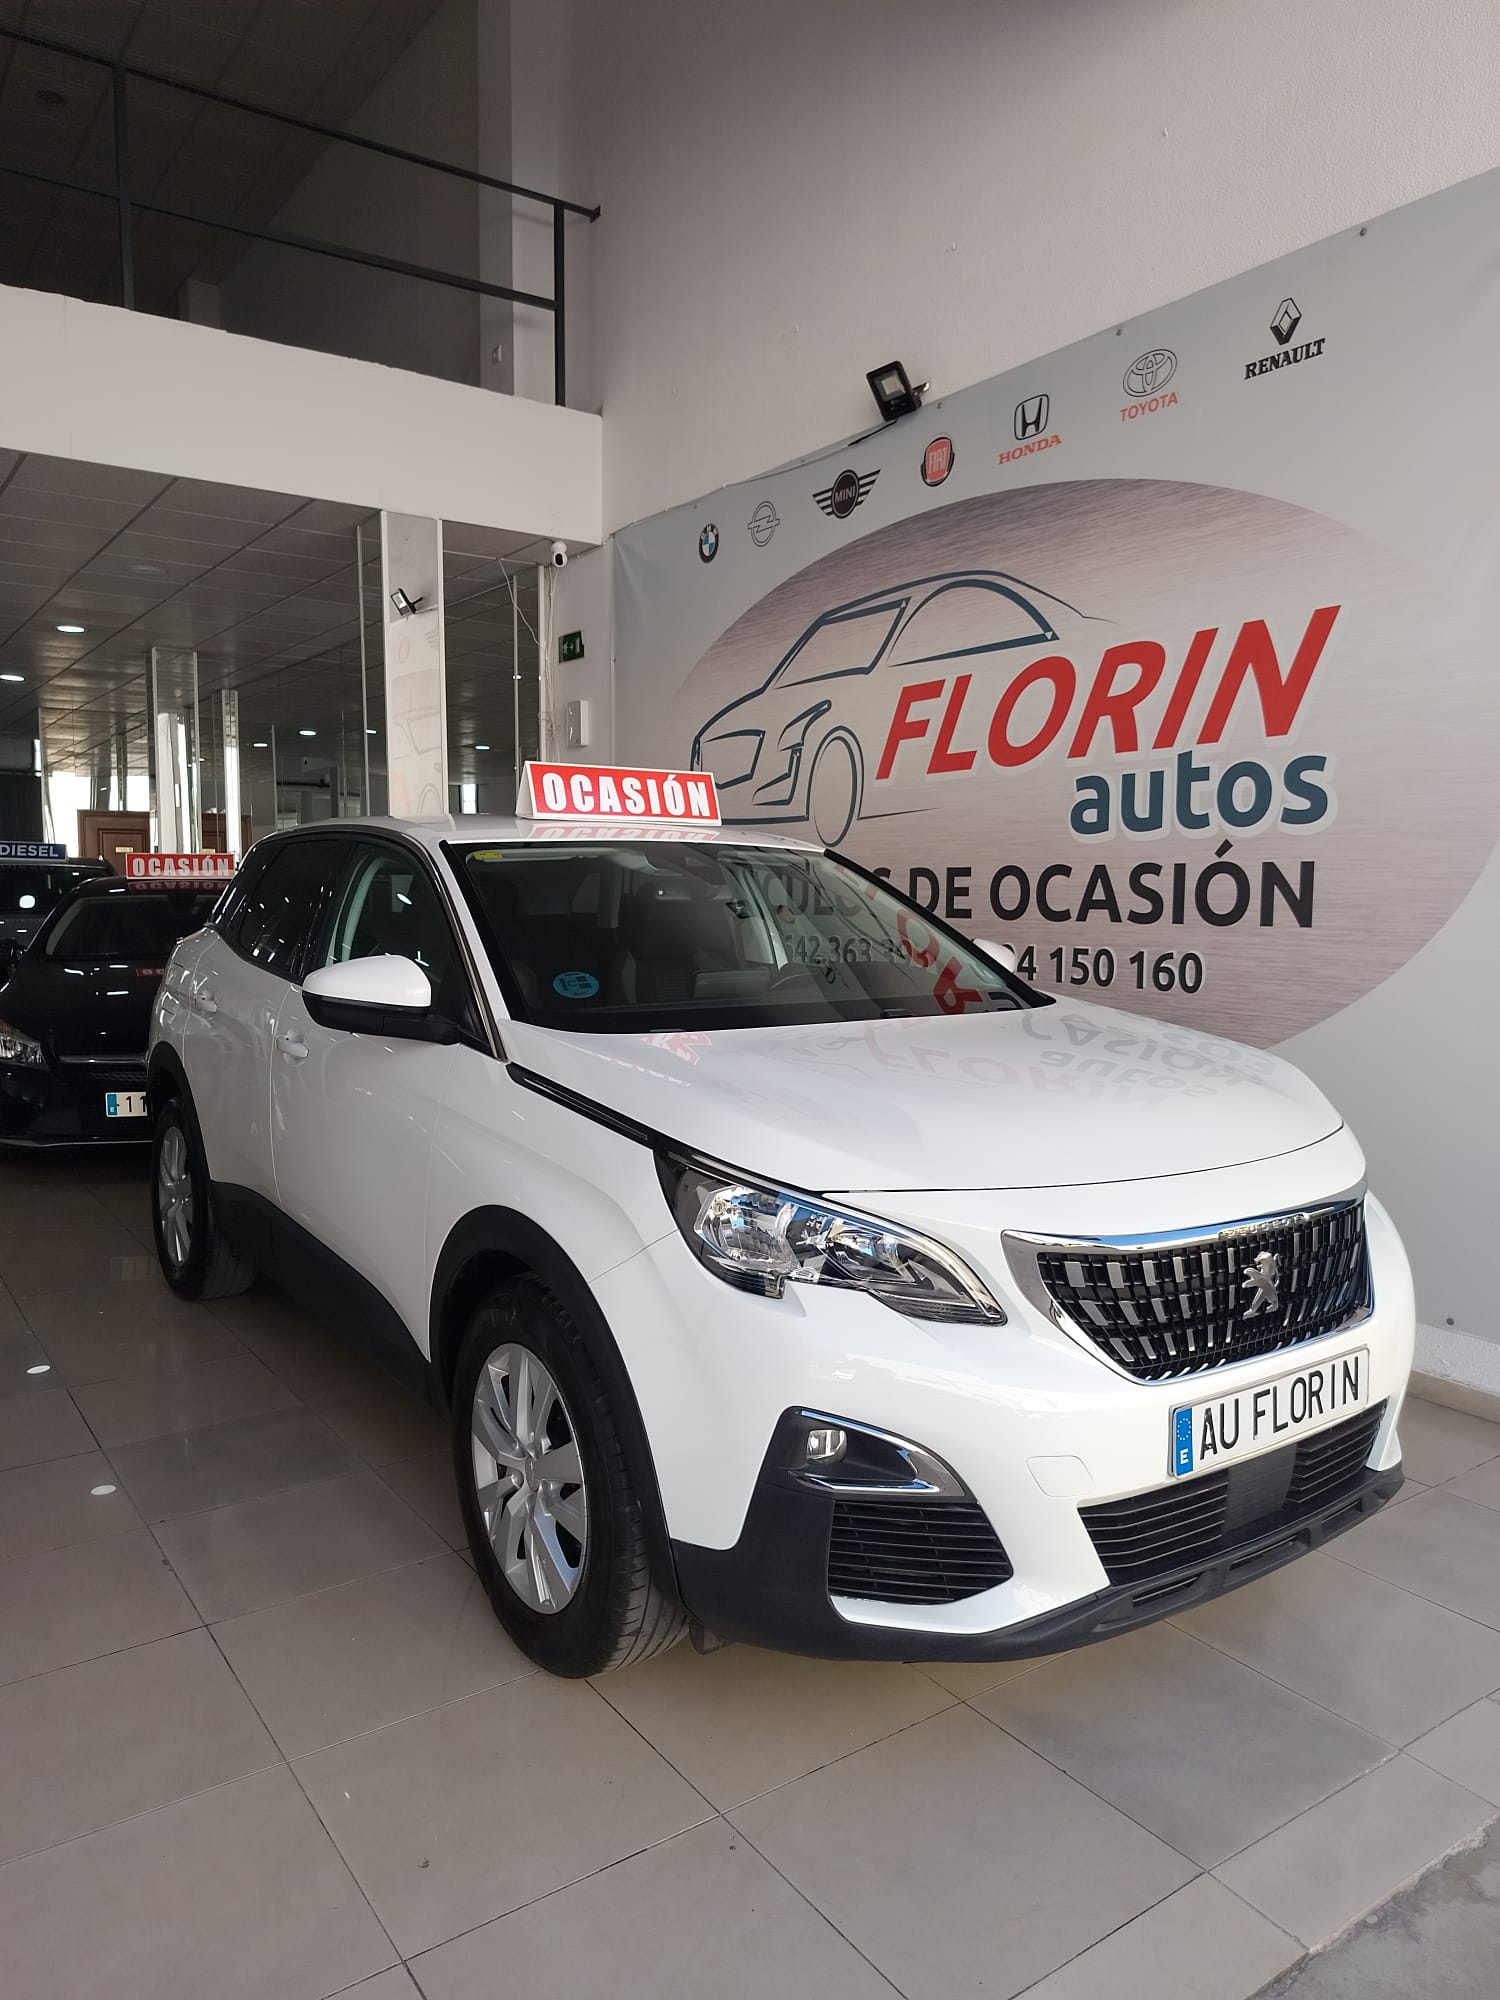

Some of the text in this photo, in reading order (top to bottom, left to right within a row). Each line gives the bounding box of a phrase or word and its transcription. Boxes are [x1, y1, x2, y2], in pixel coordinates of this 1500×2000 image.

[1244, 338, 1326, 380] RENAULT
[1120, 392, 1178, 422] TOYOTA
[928, 446, 949, 473] FIAT
[998, 434, 1062, 465] HONDA
[834, 486, 856, 502] MINI
[875, 605, 1341, 781] FLORIN
[542, 772, 711, 817] OCASIÓN
[1070, 750, 1328, 835] autos
[0, 844, 59, 858] DIESEL
[132, 856, 230, 878] OCASIÓN
[909, 866, 973, 919] DE
[989, 838, 1316, 928] OCASIÓN
[1049, 947, 1116, 988] 150
[1129, 951, 1204, 994] 160
[1180, 1356, 1359, 1465] E AU FLORIN
